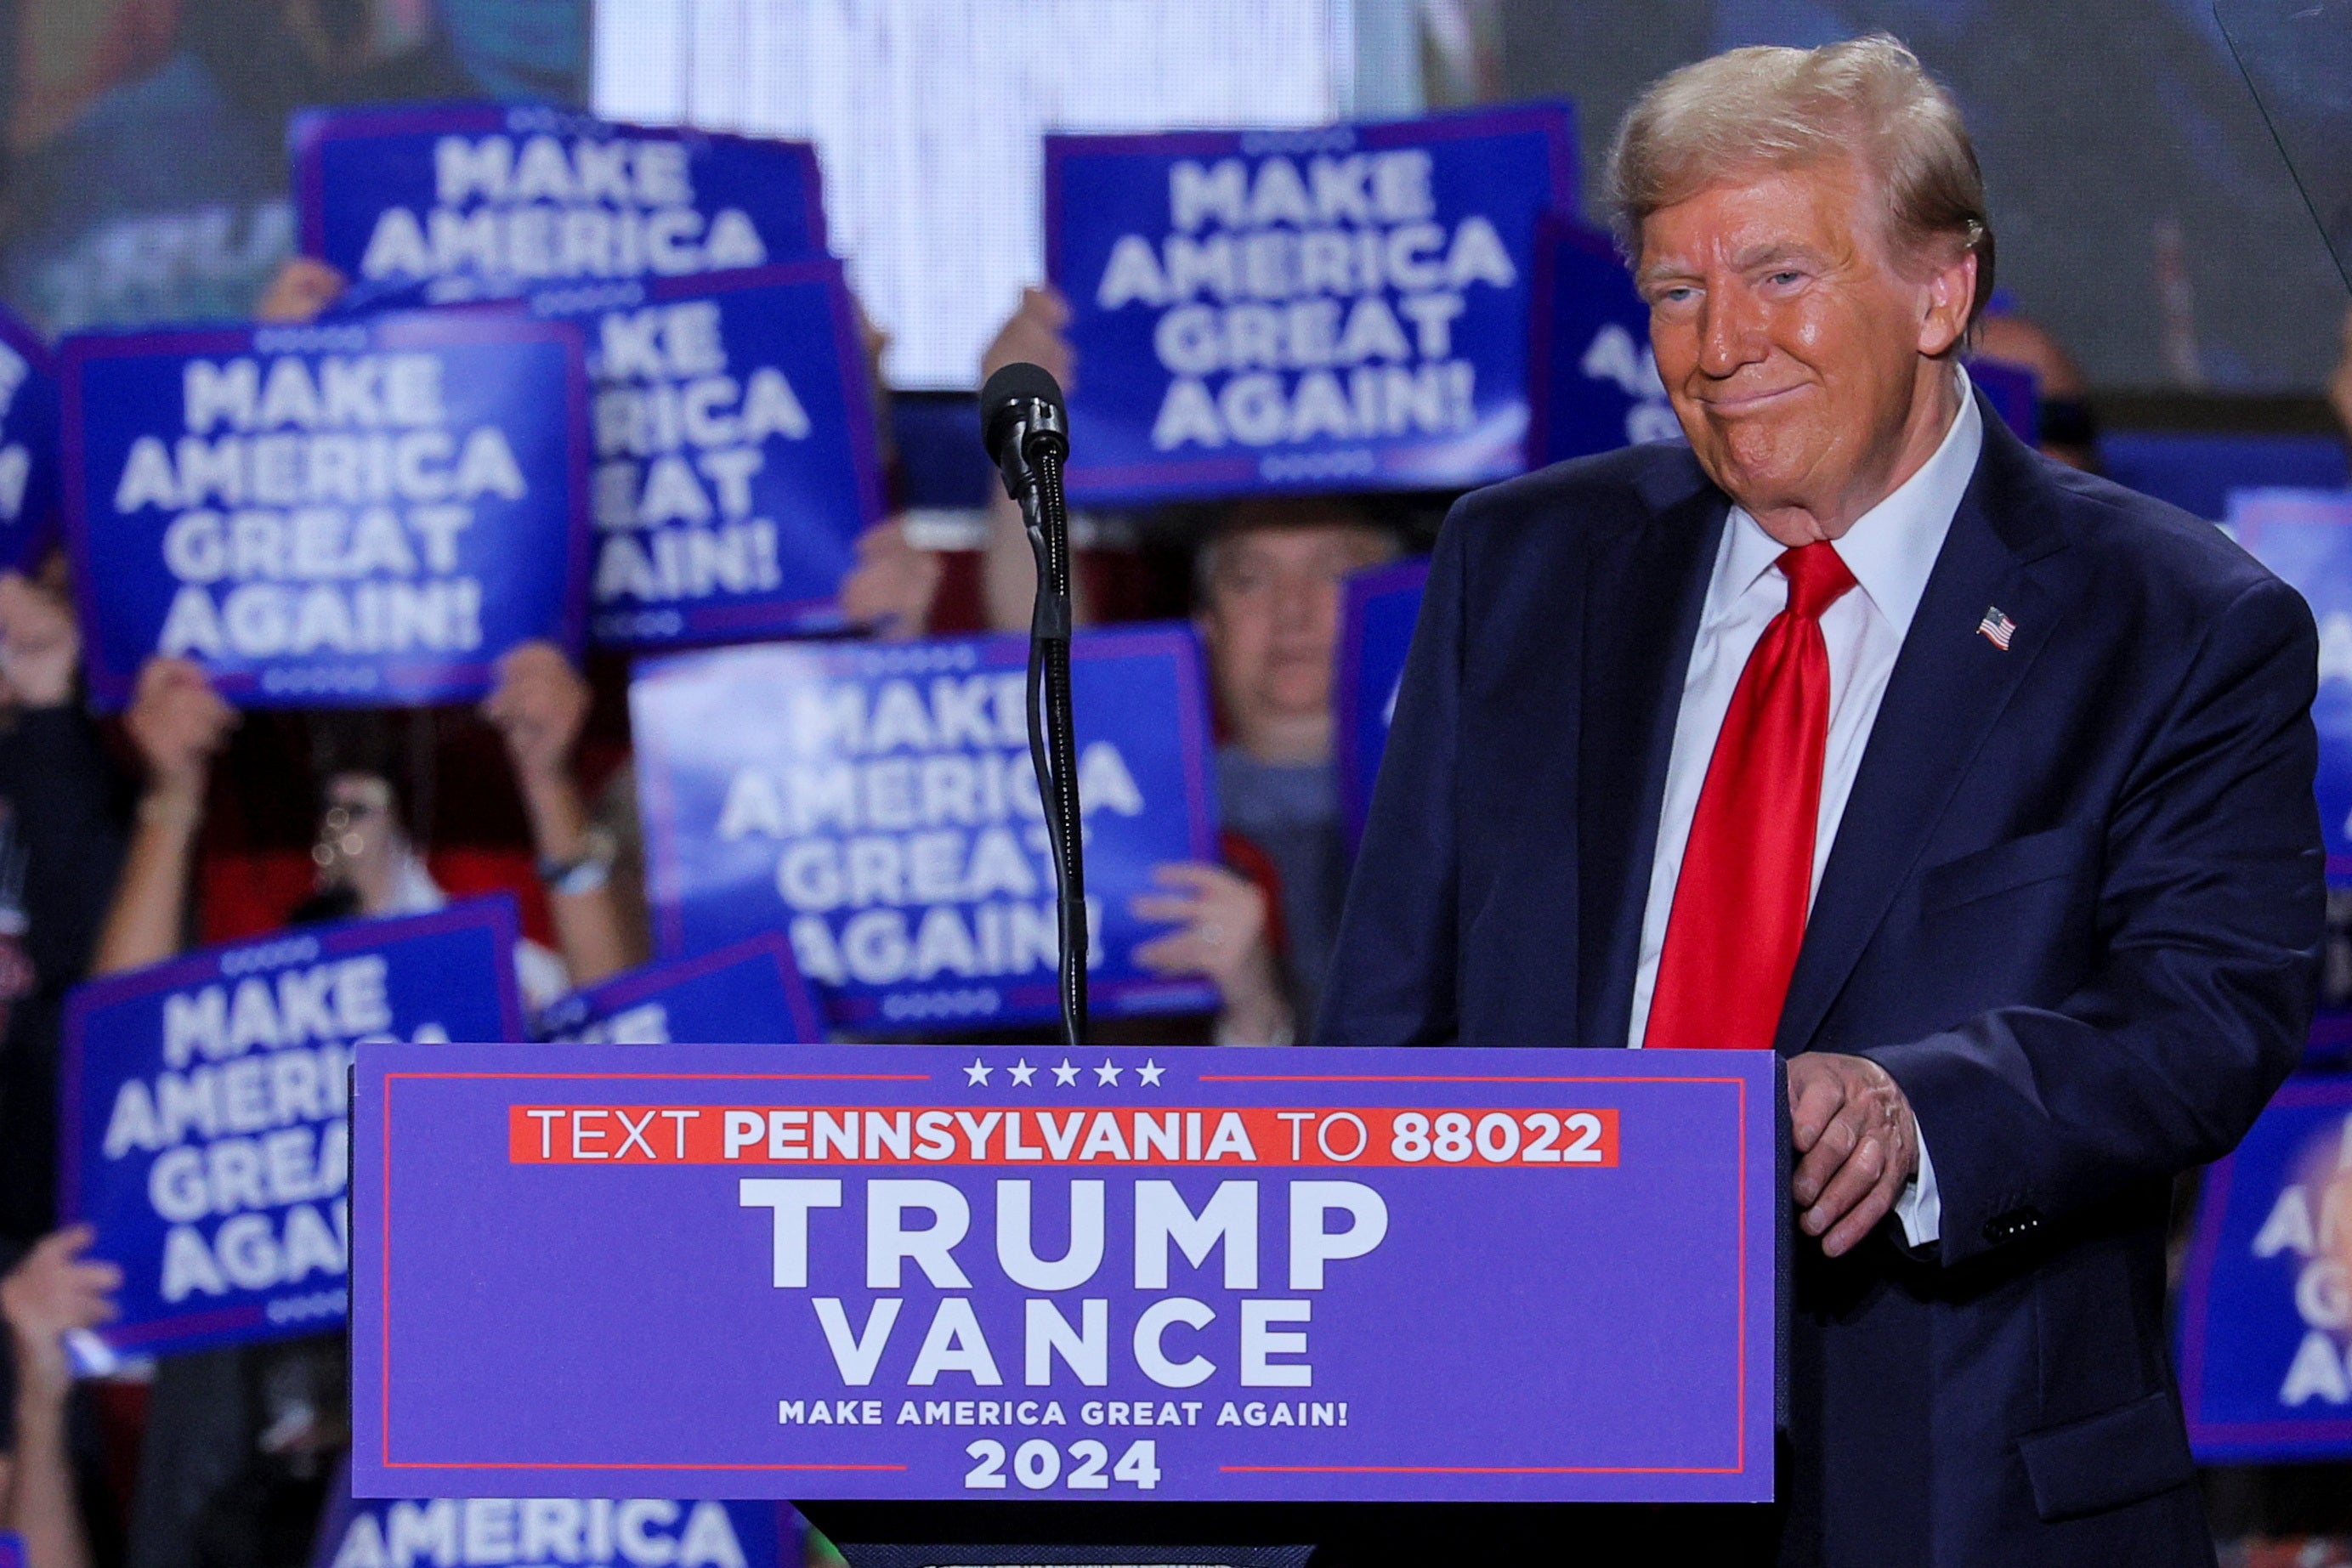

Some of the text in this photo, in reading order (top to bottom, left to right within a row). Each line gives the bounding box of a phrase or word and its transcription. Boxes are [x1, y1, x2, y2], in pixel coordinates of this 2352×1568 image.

[435, 134, 694, 206] MAKE
[1168, 149, 1435, 229] MAKE
[361, 206, 767, 279] AMERICA
[1097, 216, 1517, 311] AMERICA
[598, 299, 728, 377] KE
[1153, 292, 1466, 379] GREAT
[181, 355, 444, 433] MAKE
[593, 367, 811, 456] RICA
[1151, 359, 1480, 452] AGAIN!
[114, 427, 528, 513] AMERICA
[593, 447, 763, 529] EAT
[163, 506, 474, 585] GREAT
[594, 517, 781, 603] AIN!
[158, 575, 483, 660] AGAIN!
[162, 953, 393, 1069] MAKE
[103, 1023, 451, 1160] AMERI
[148, 1118, 348, 1222] GRE
[526, 1109, 1603, 1163] TEXT PENNSYLVANIA TO 88022
[739, 1178, 1389, 1291] TRUMP
[811, 1297, 1313, 1388] VANCE
[778, 1401, 1349, 1427] MAKE AMERICA GREAT AGAIN!
[964, 1438, 1161, 1490] 2024
[332, 1498, 748, 1567] AMERICA
